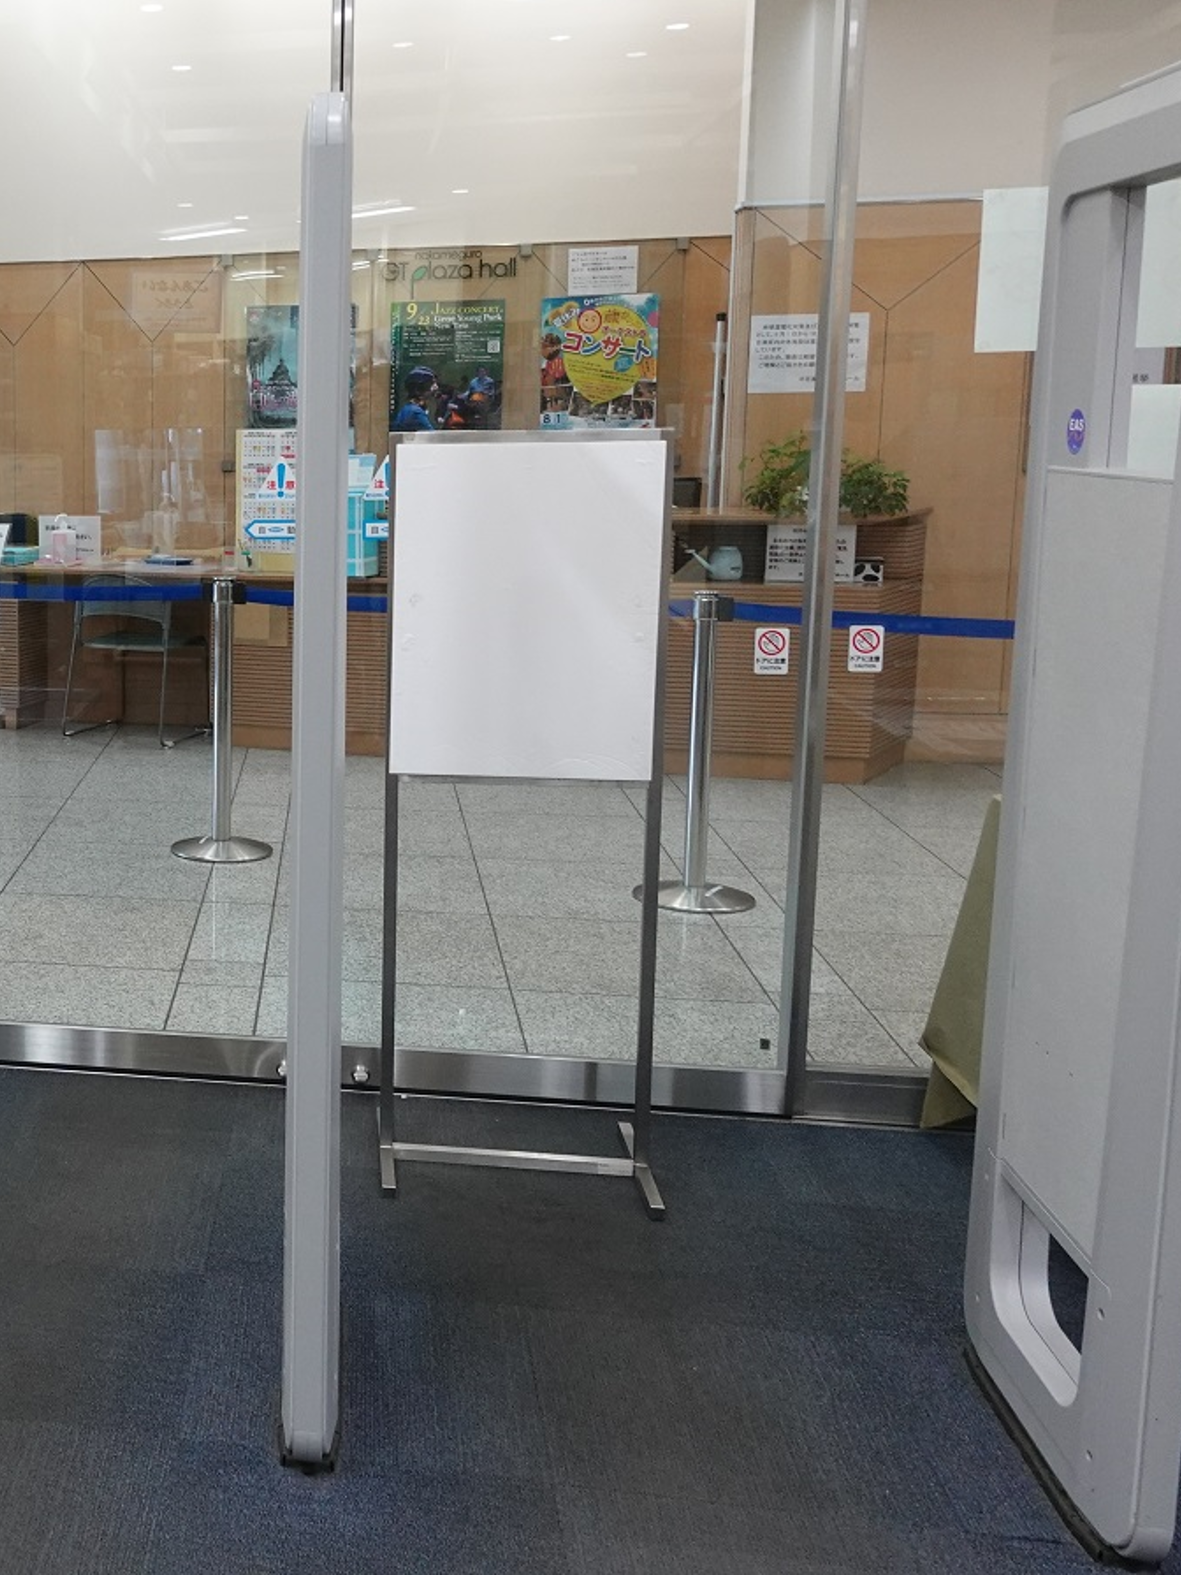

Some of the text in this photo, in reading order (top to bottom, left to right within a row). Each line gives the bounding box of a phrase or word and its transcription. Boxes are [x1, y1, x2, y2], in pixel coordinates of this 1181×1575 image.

[415, 249, 483, 260] nakameguro
[479, 257, 517, 278] hall
[406, 303, 418, 320] 9
[561, 331, 651, 363] コンサート
[1069, 418, 1085, 431] EAS
[756, 657, 786, 665] ドアに注意
[851, 655, 880, 663] ドアに注意
